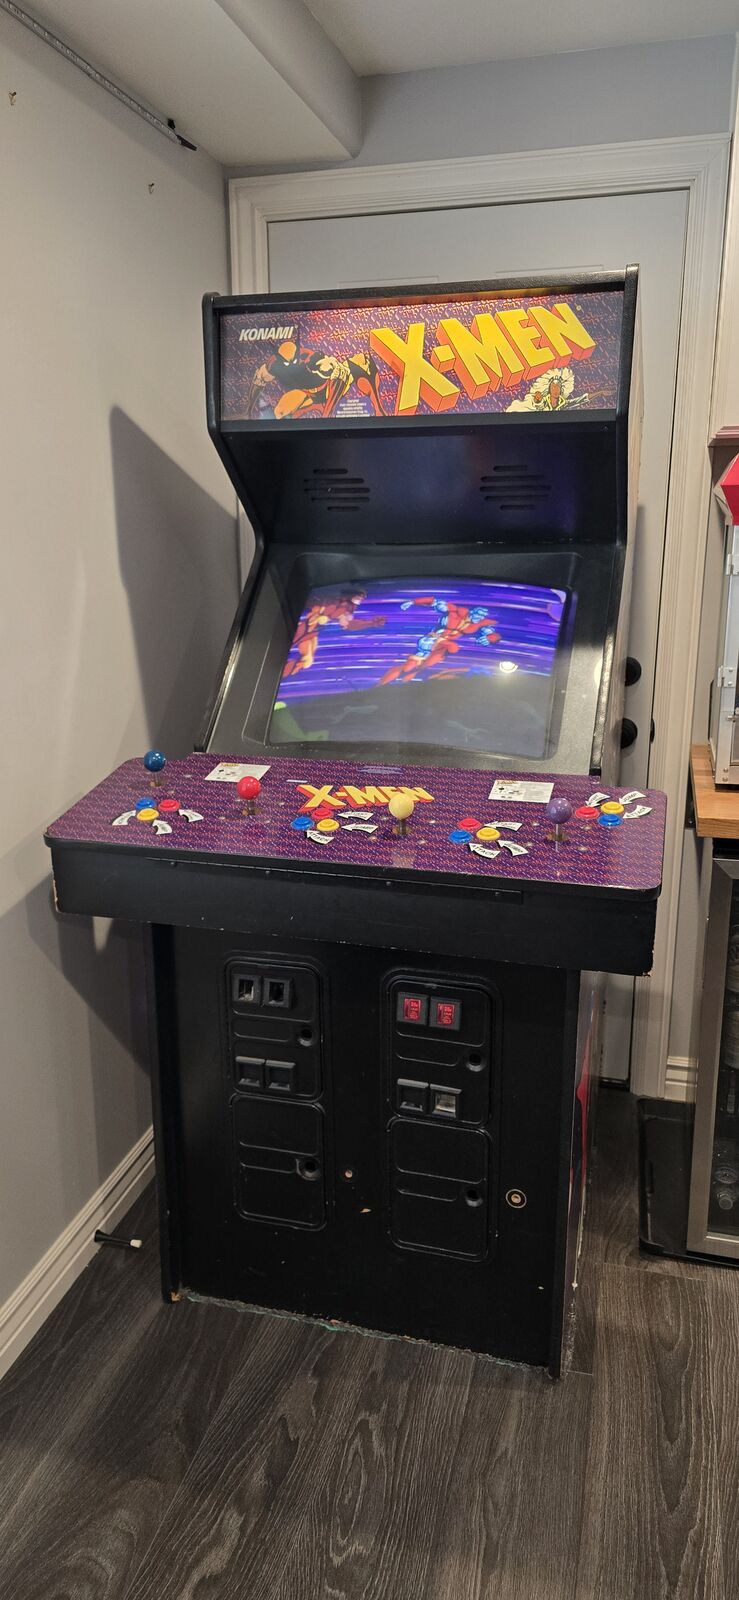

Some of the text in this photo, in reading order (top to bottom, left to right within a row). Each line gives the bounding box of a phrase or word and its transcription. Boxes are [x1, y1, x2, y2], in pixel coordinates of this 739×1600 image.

[238, 325, 294, 342] KONAMI
[370, 303, 598, 415] X-MEN
[471, 844, 496, 857] ATTACK
